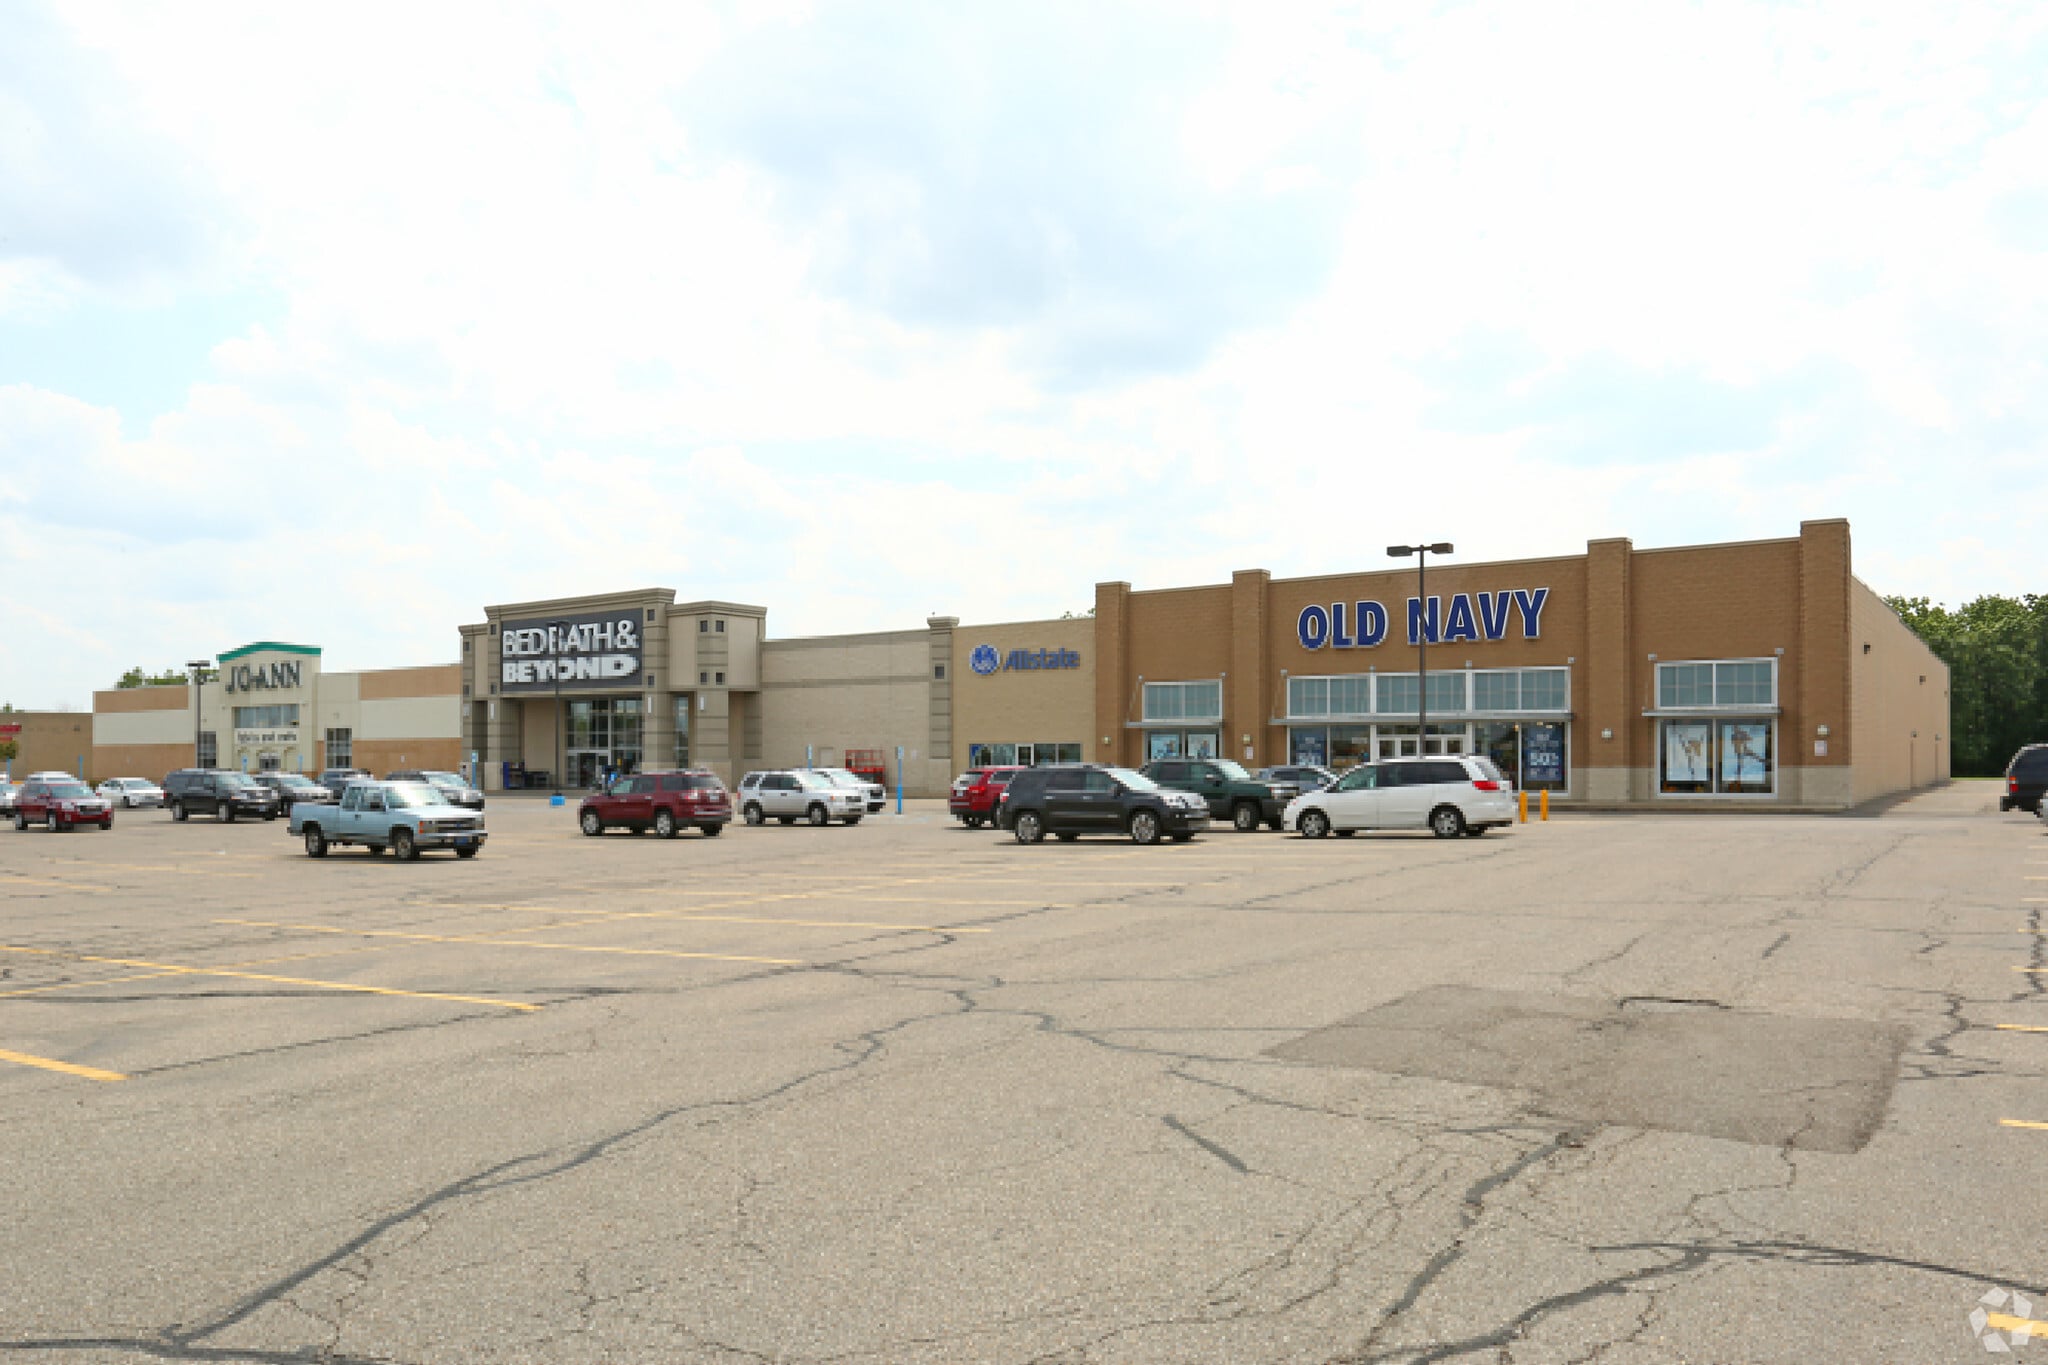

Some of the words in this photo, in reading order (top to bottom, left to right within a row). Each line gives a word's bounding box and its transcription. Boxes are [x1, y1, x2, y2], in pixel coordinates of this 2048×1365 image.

[1297, 601, 1388, 650] OLD
[1406, 587, 1549, 645] NAVY
[503, 628, 547, 655] BED
[549, 622, 615, 654] BATH
[616, 620, 639, 648] &
[503, 654, 639, 682] BEYOND
[1003, 648, 1080, 671] Allstate
